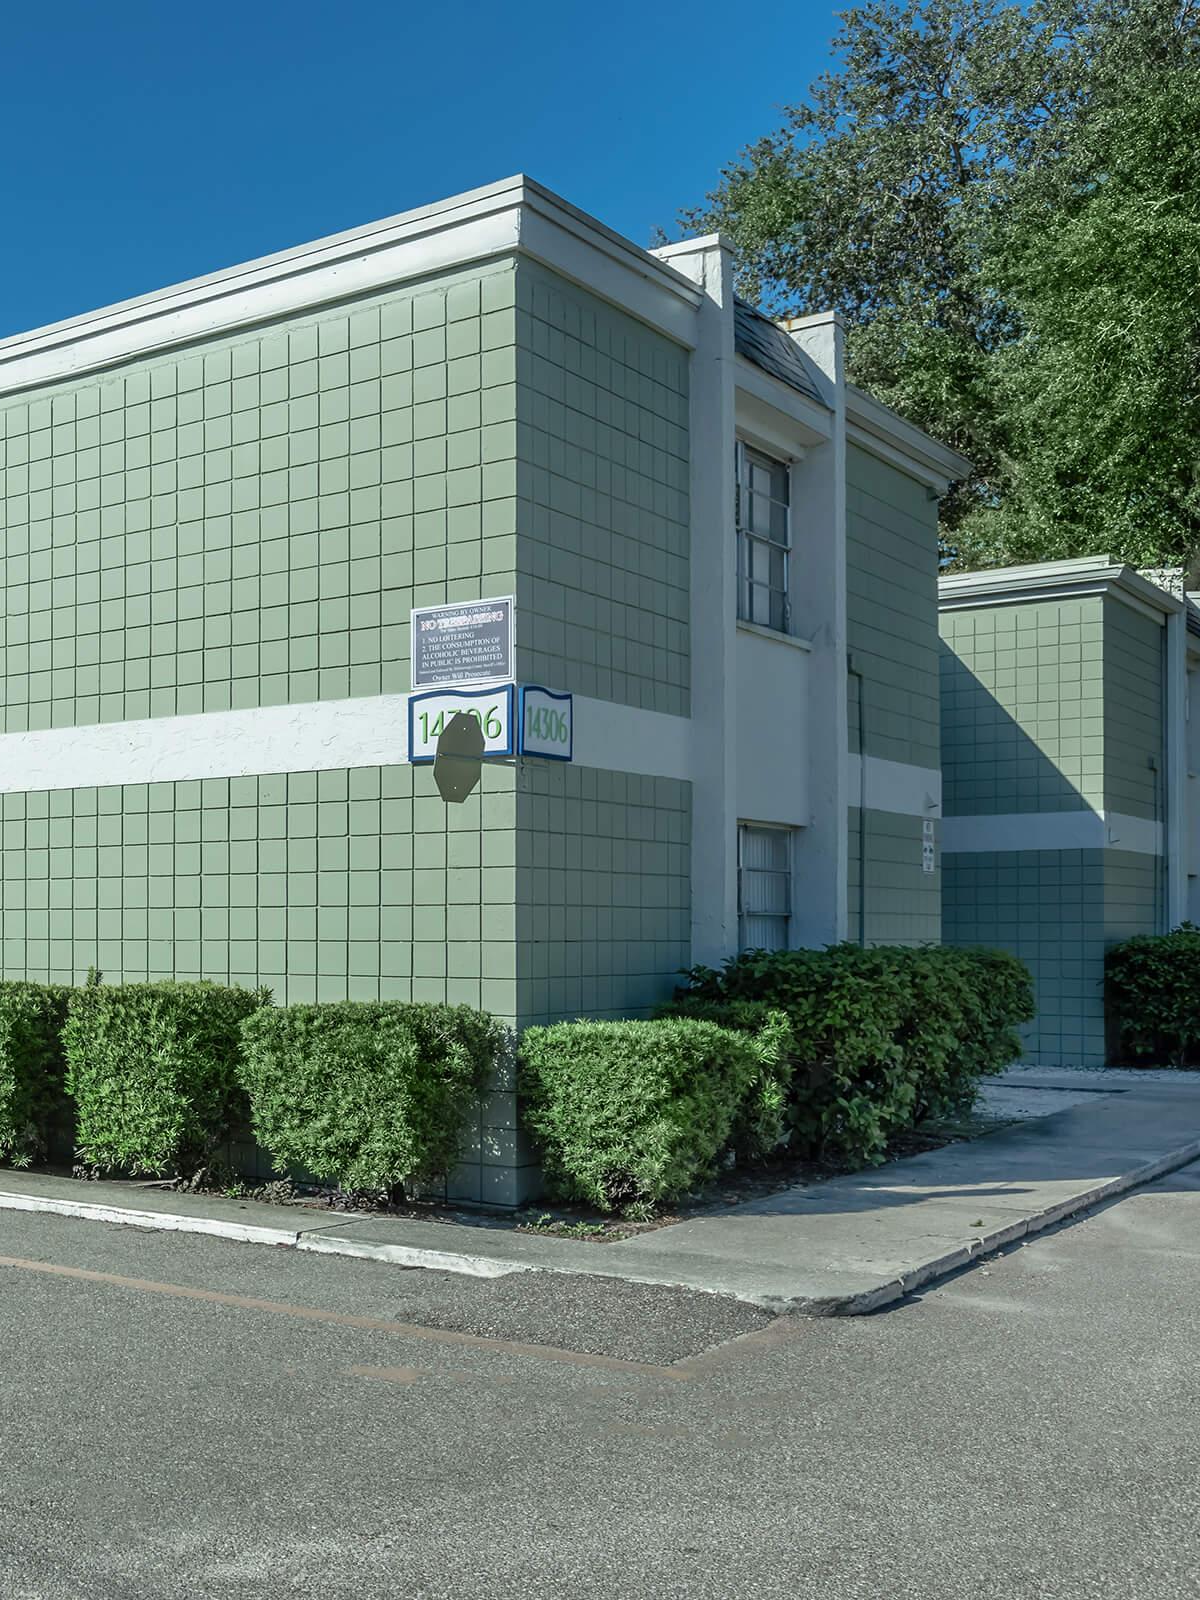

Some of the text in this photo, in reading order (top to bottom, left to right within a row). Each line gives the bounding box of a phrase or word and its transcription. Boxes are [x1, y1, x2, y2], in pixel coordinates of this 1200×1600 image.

[421, 620, 436, 631] NO
[439, 632, 475, 643] LOITERING
[428, 644, 441, 652] THE
[442, 638, 490, 650] CONSUMPTION
[422, 645, 501, 660] ALCOHOLIC BEVERAGES
[430, 658, 454, 667] PUBLIC
[462, 653, 503, 664] PROHIBITED
[419, 705, 502, 744] 146
[527, 704, 568, 744] 14306
